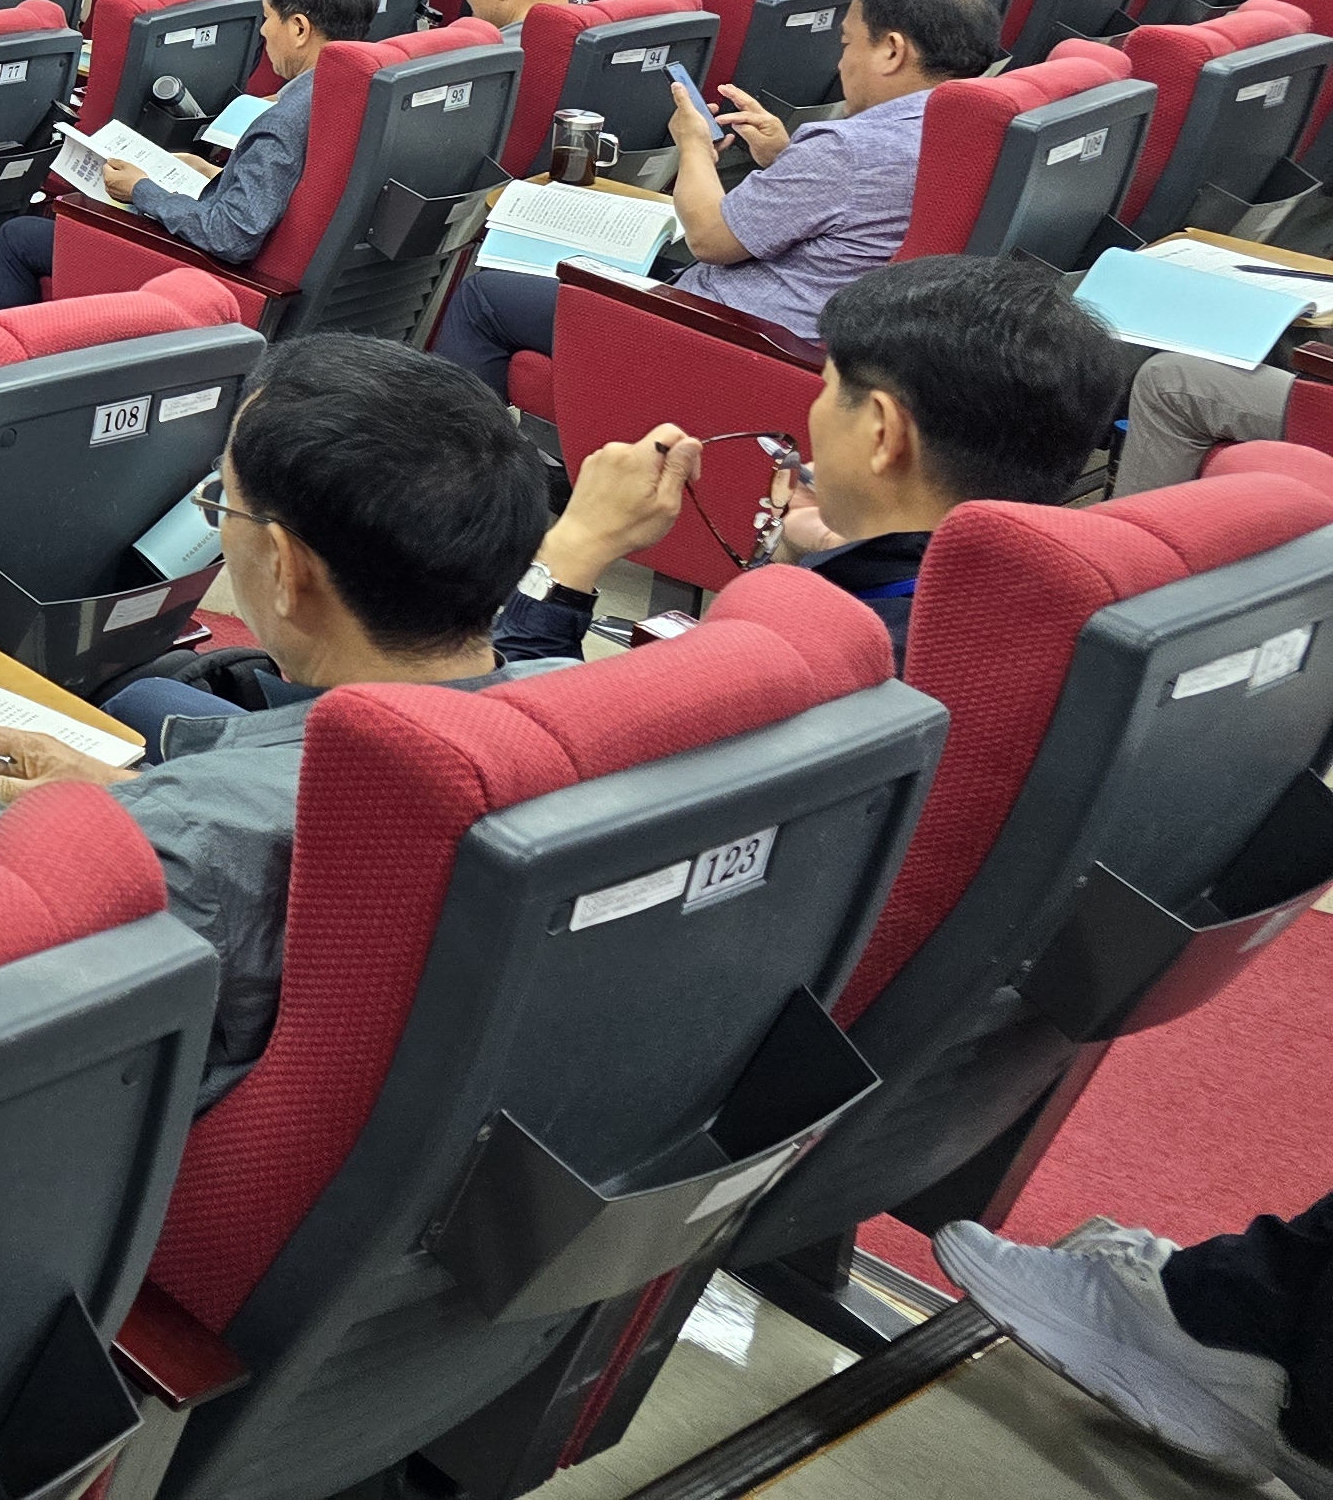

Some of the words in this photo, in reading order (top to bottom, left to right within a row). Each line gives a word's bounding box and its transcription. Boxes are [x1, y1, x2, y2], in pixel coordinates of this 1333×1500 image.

[200, 30, 211, 41] 78
[648, 50, 661, 65] 94
[7, 66, 21, 77] 77
[451, 88, 465, 103] 93
[101, 405, 140, 435] 108
[703, 837, 762, 888] 123
